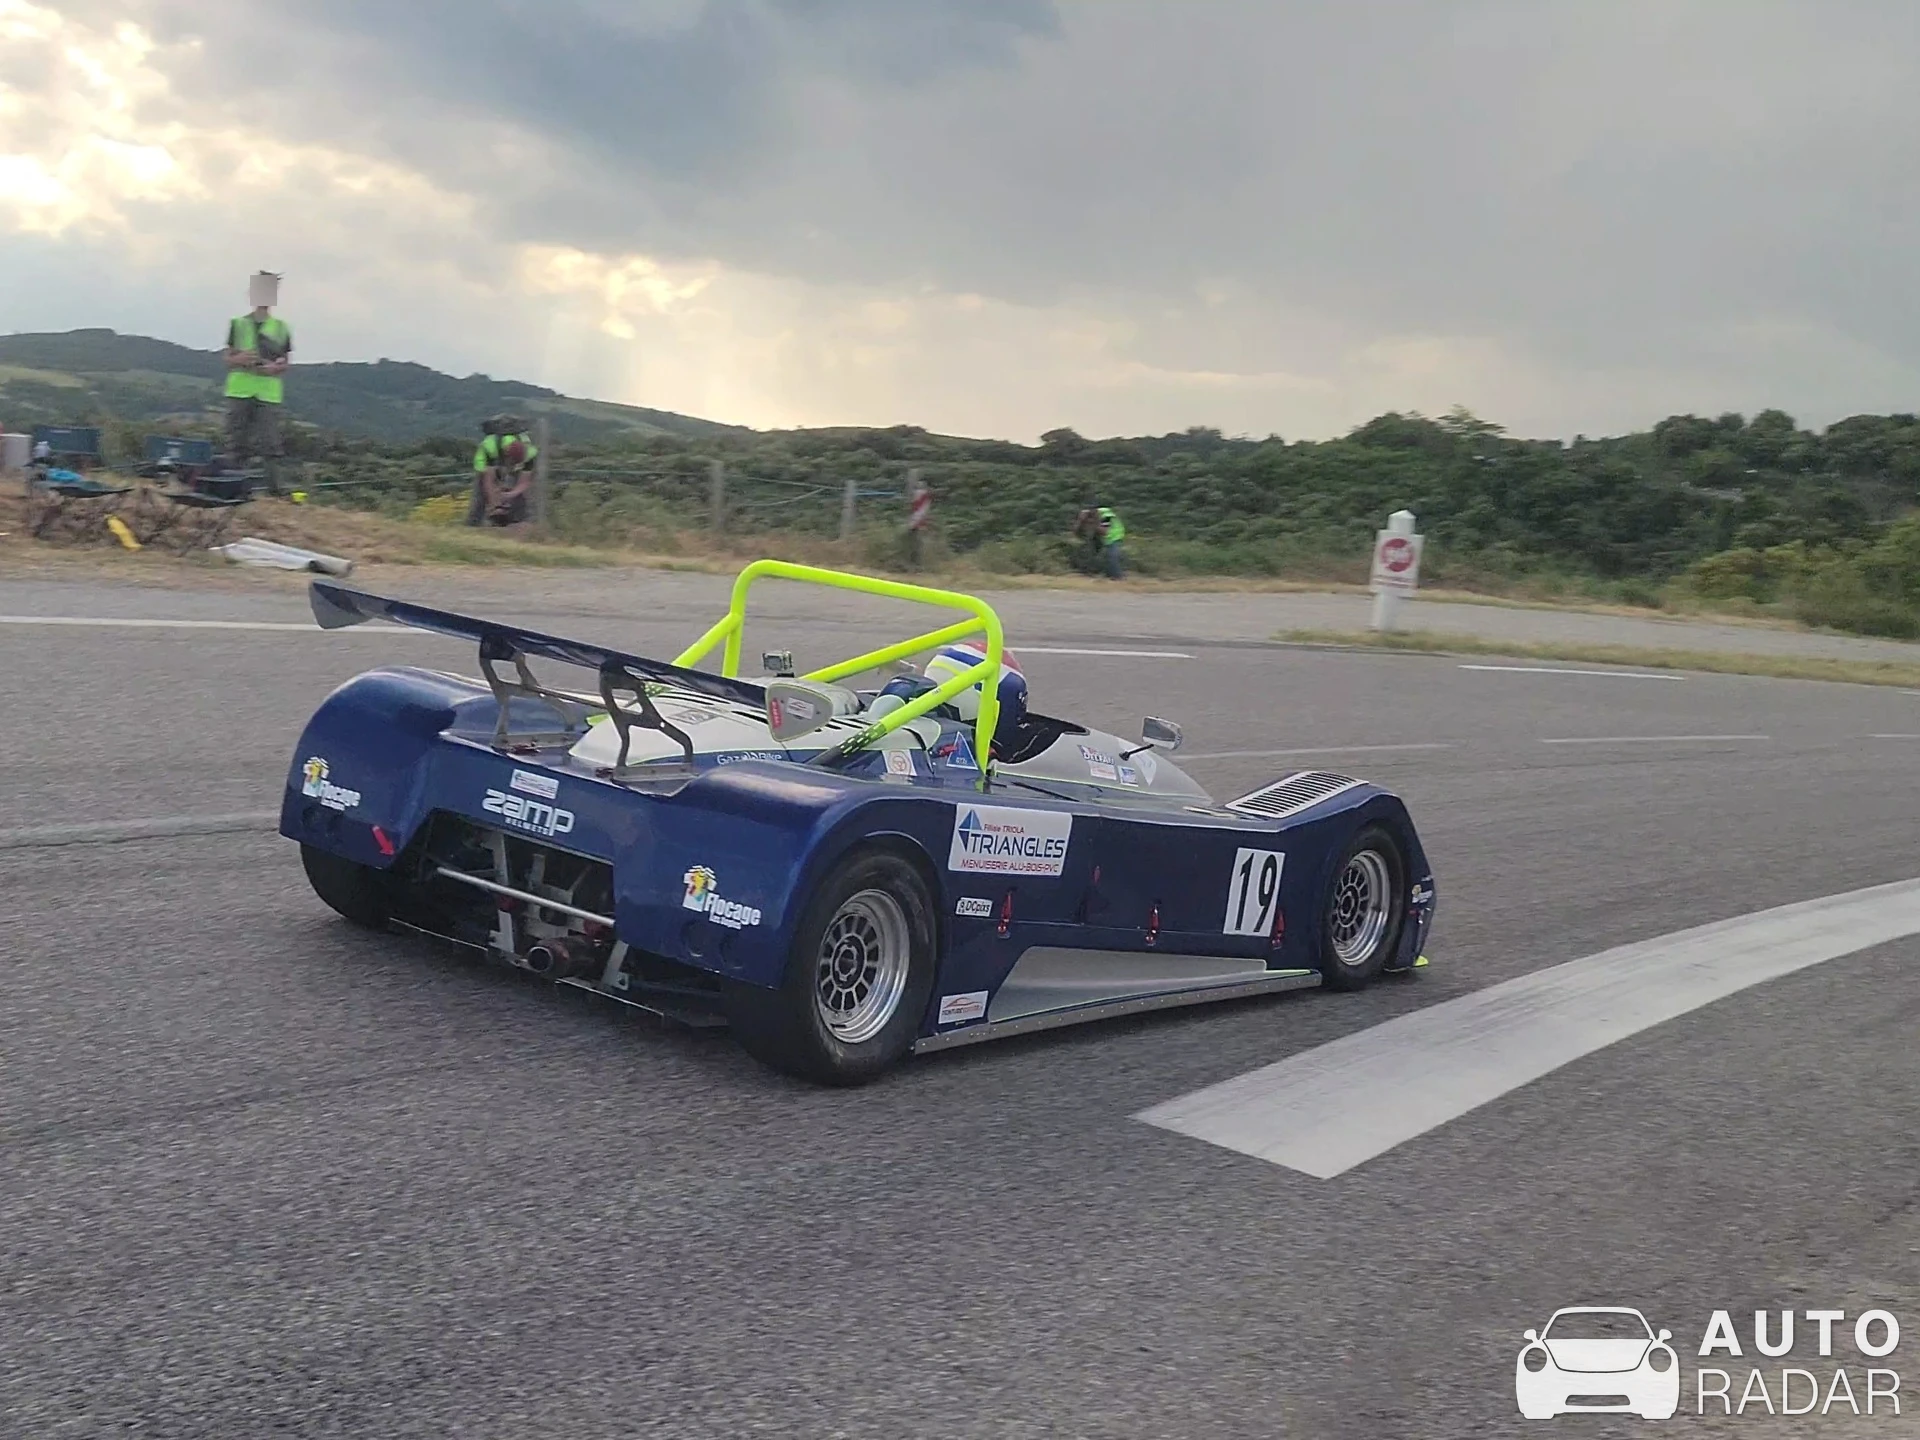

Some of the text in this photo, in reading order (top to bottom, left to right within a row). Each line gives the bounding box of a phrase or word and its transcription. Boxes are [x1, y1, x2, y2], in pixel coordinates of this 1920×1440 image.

[482, 788, 575, 837] zamp
[505, 816, 550, 836] HELMETS
[970, 832, 1066, 859] TRIANGLES
[961, 859, 1008, 870] MENUISERIE
[1234, 852, 1278, 933] 19
[704, 891, 762, 926] Flocage
